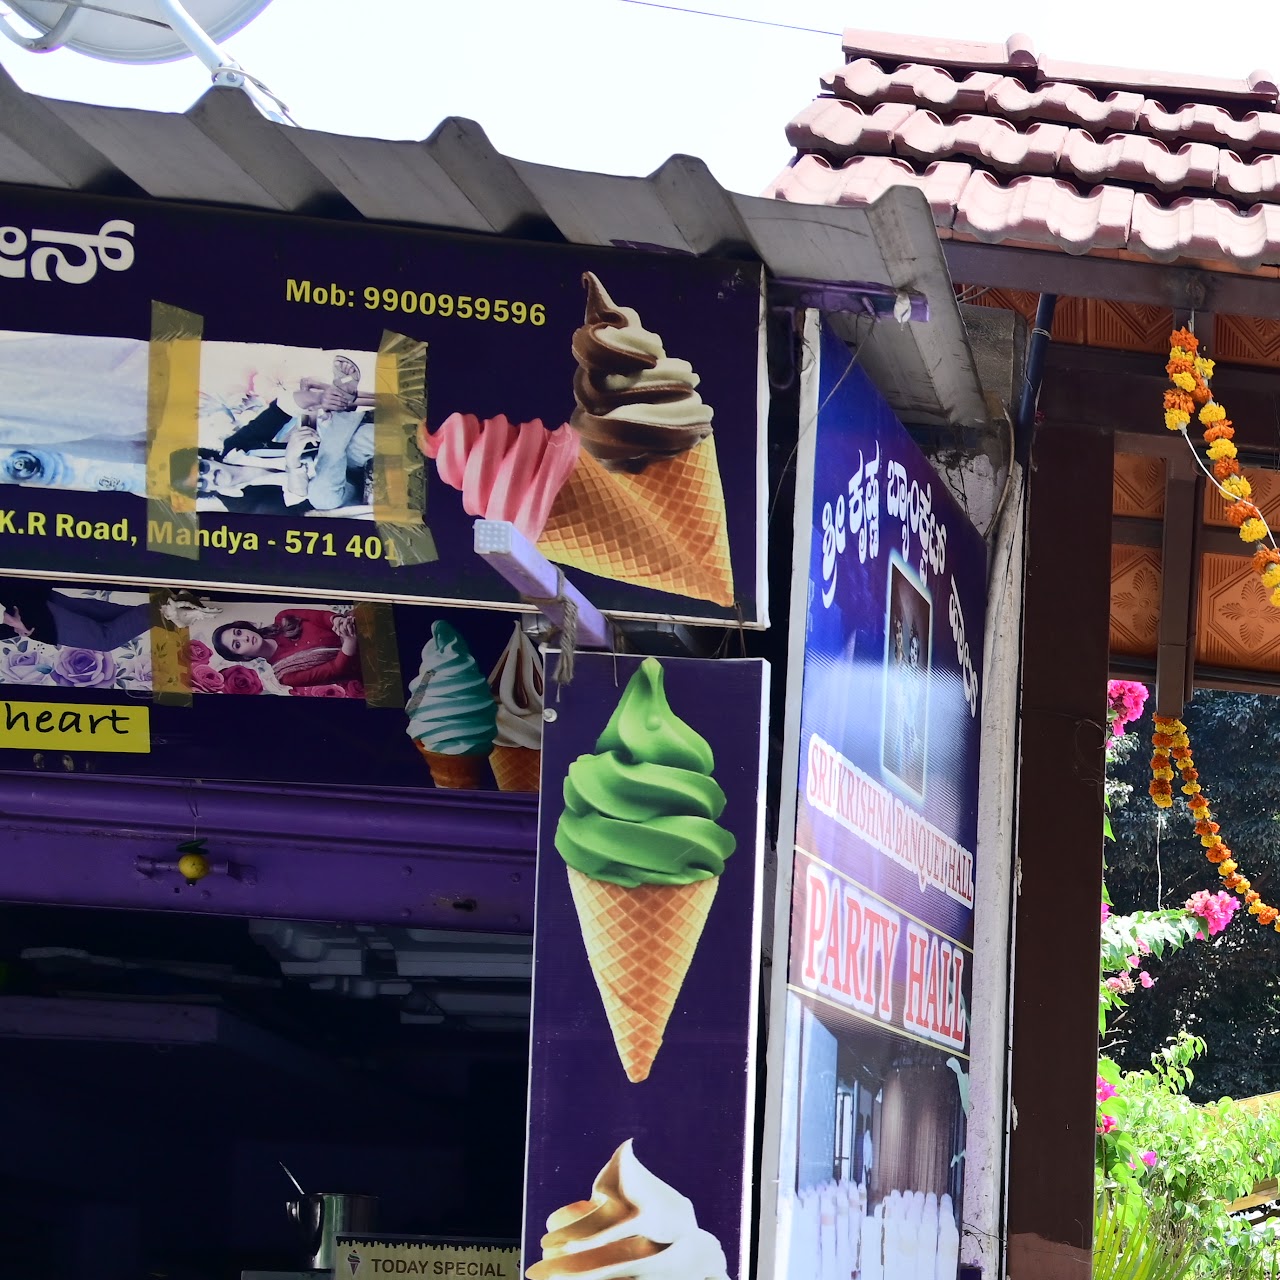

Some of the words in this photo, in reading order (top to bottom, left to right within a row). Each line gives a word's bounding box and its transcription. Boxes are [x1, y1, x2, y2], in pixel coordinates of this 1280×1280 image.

[285, 279, 355, 308] Mob:
[363, 286, 546, 327] 9900959596
[0, 509, 47, 536] K.R
[56, 513, 137, 546] Road,
[147, 520, 258, 555] Mandya
[285, 531, 337, 557] 571
[345, 535, 397, 560] 401
[822, 494, 846, 609] ಶ್ರೀ
[848, 440, 880, 564] ಕೃಷ್ಣ
[949, 574, 979, 718] ಹಾಲ್
[5, 702, 130, 735] heart
[809, 741, 834, 807] SRI
[836, 760, 893, 850] KRISHNA
[895, 807, 947, 886] BANQUET
[949, 846, 974, 903] HALL
[805, 875, 898, 1013] PARTY
[906, 931, 965, 1042] HALL
[371, 1258, 429, 1275] TODAY
[432, 1260, 506, 1278] SPECIAL
